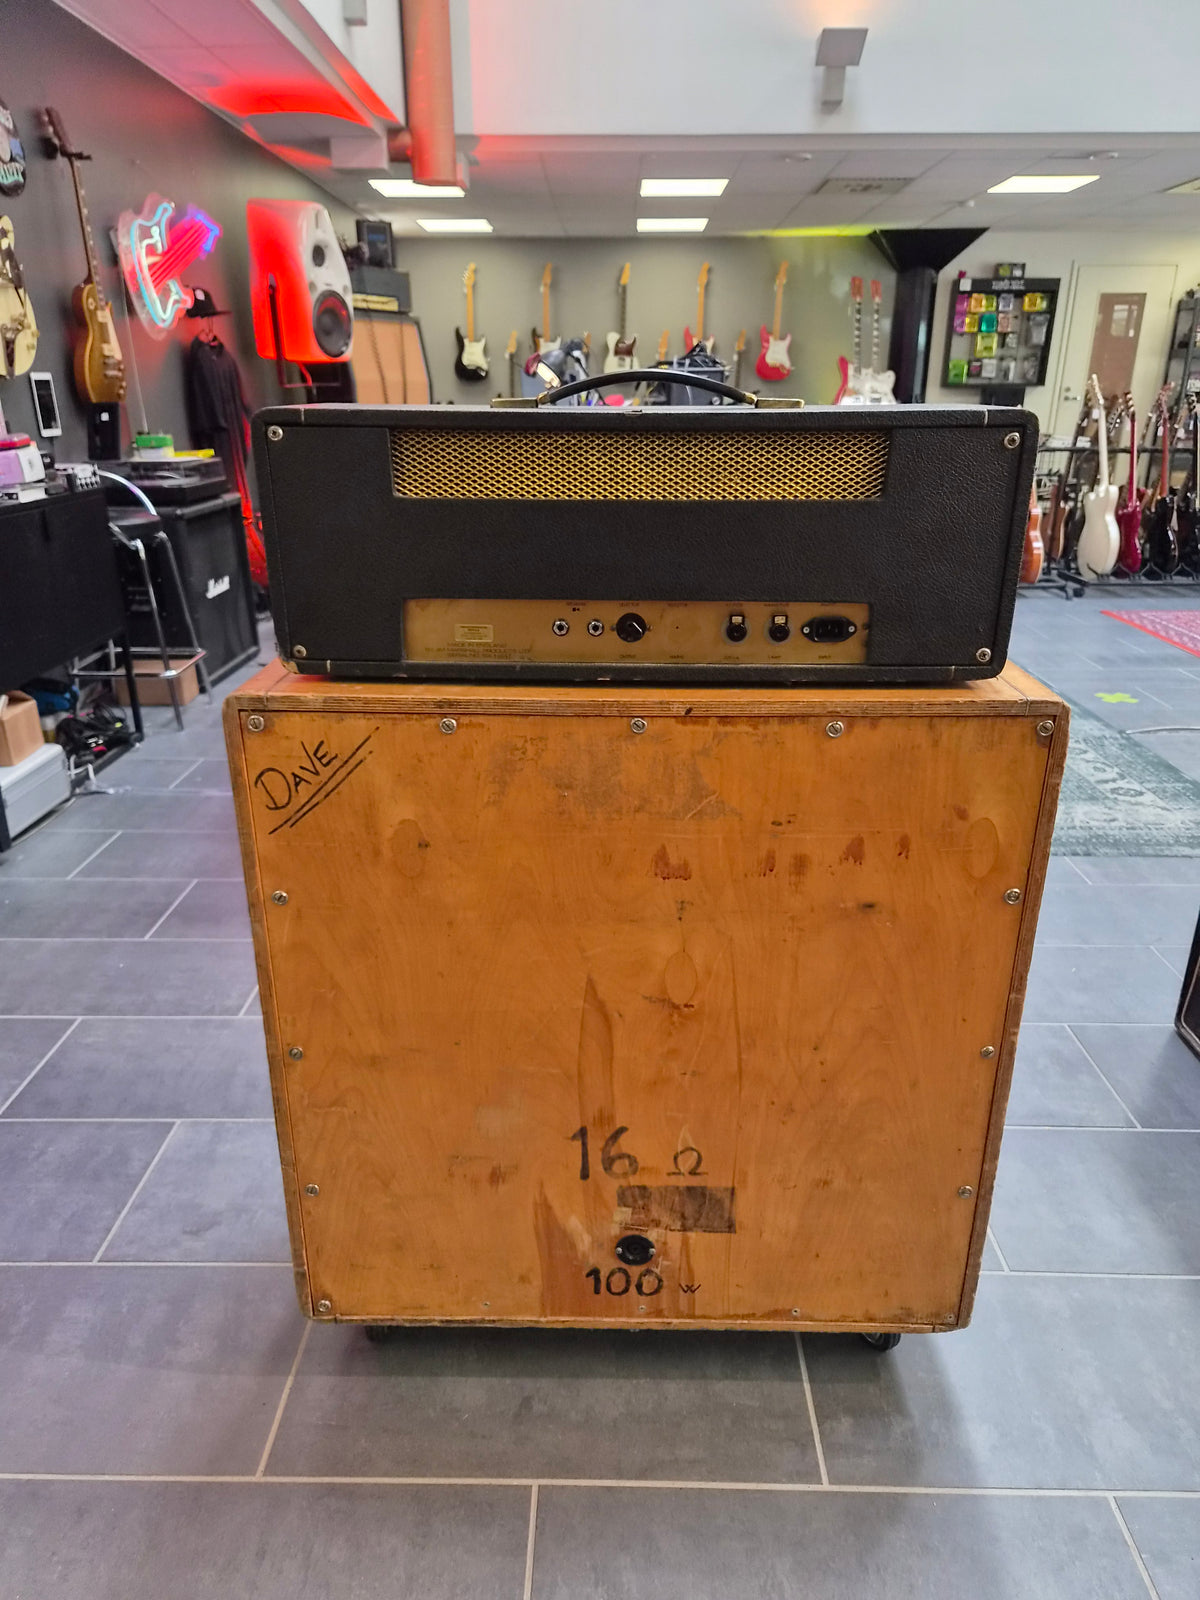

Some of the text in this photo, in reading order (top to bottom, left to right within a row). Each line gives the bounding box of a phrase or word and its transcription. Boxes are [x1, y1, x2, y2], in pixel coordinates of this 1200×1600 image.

[569, 1125, 709, 1181] 16 Ω
[585, 1266, 664, 1297] 100
